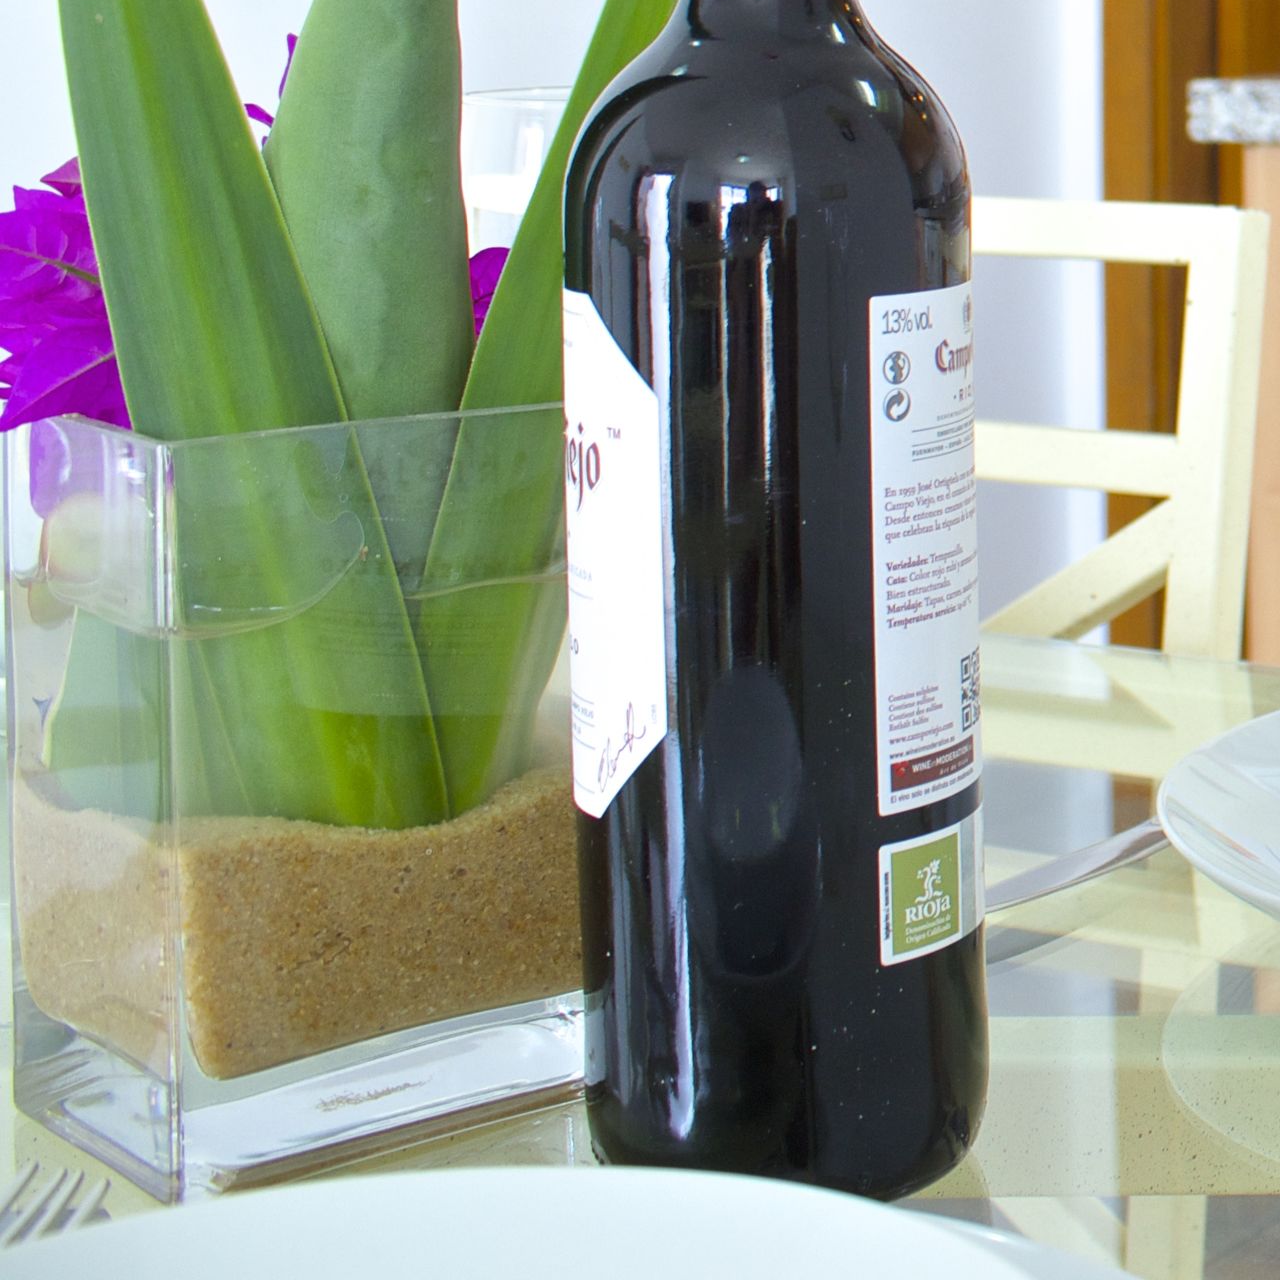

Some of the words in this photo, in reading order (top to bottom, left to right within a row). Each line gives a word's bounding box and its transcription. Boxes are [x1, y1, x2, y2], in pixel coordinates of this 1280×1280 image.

[882, 307, 913, 335] 13%
[885, 487, 896, 497] En
[885, 501, 914, 517] Campo
[885, 515, 911, 526] Desde
[885, 531, 901, 544] que
[887, 590, 906, 600] Bien
